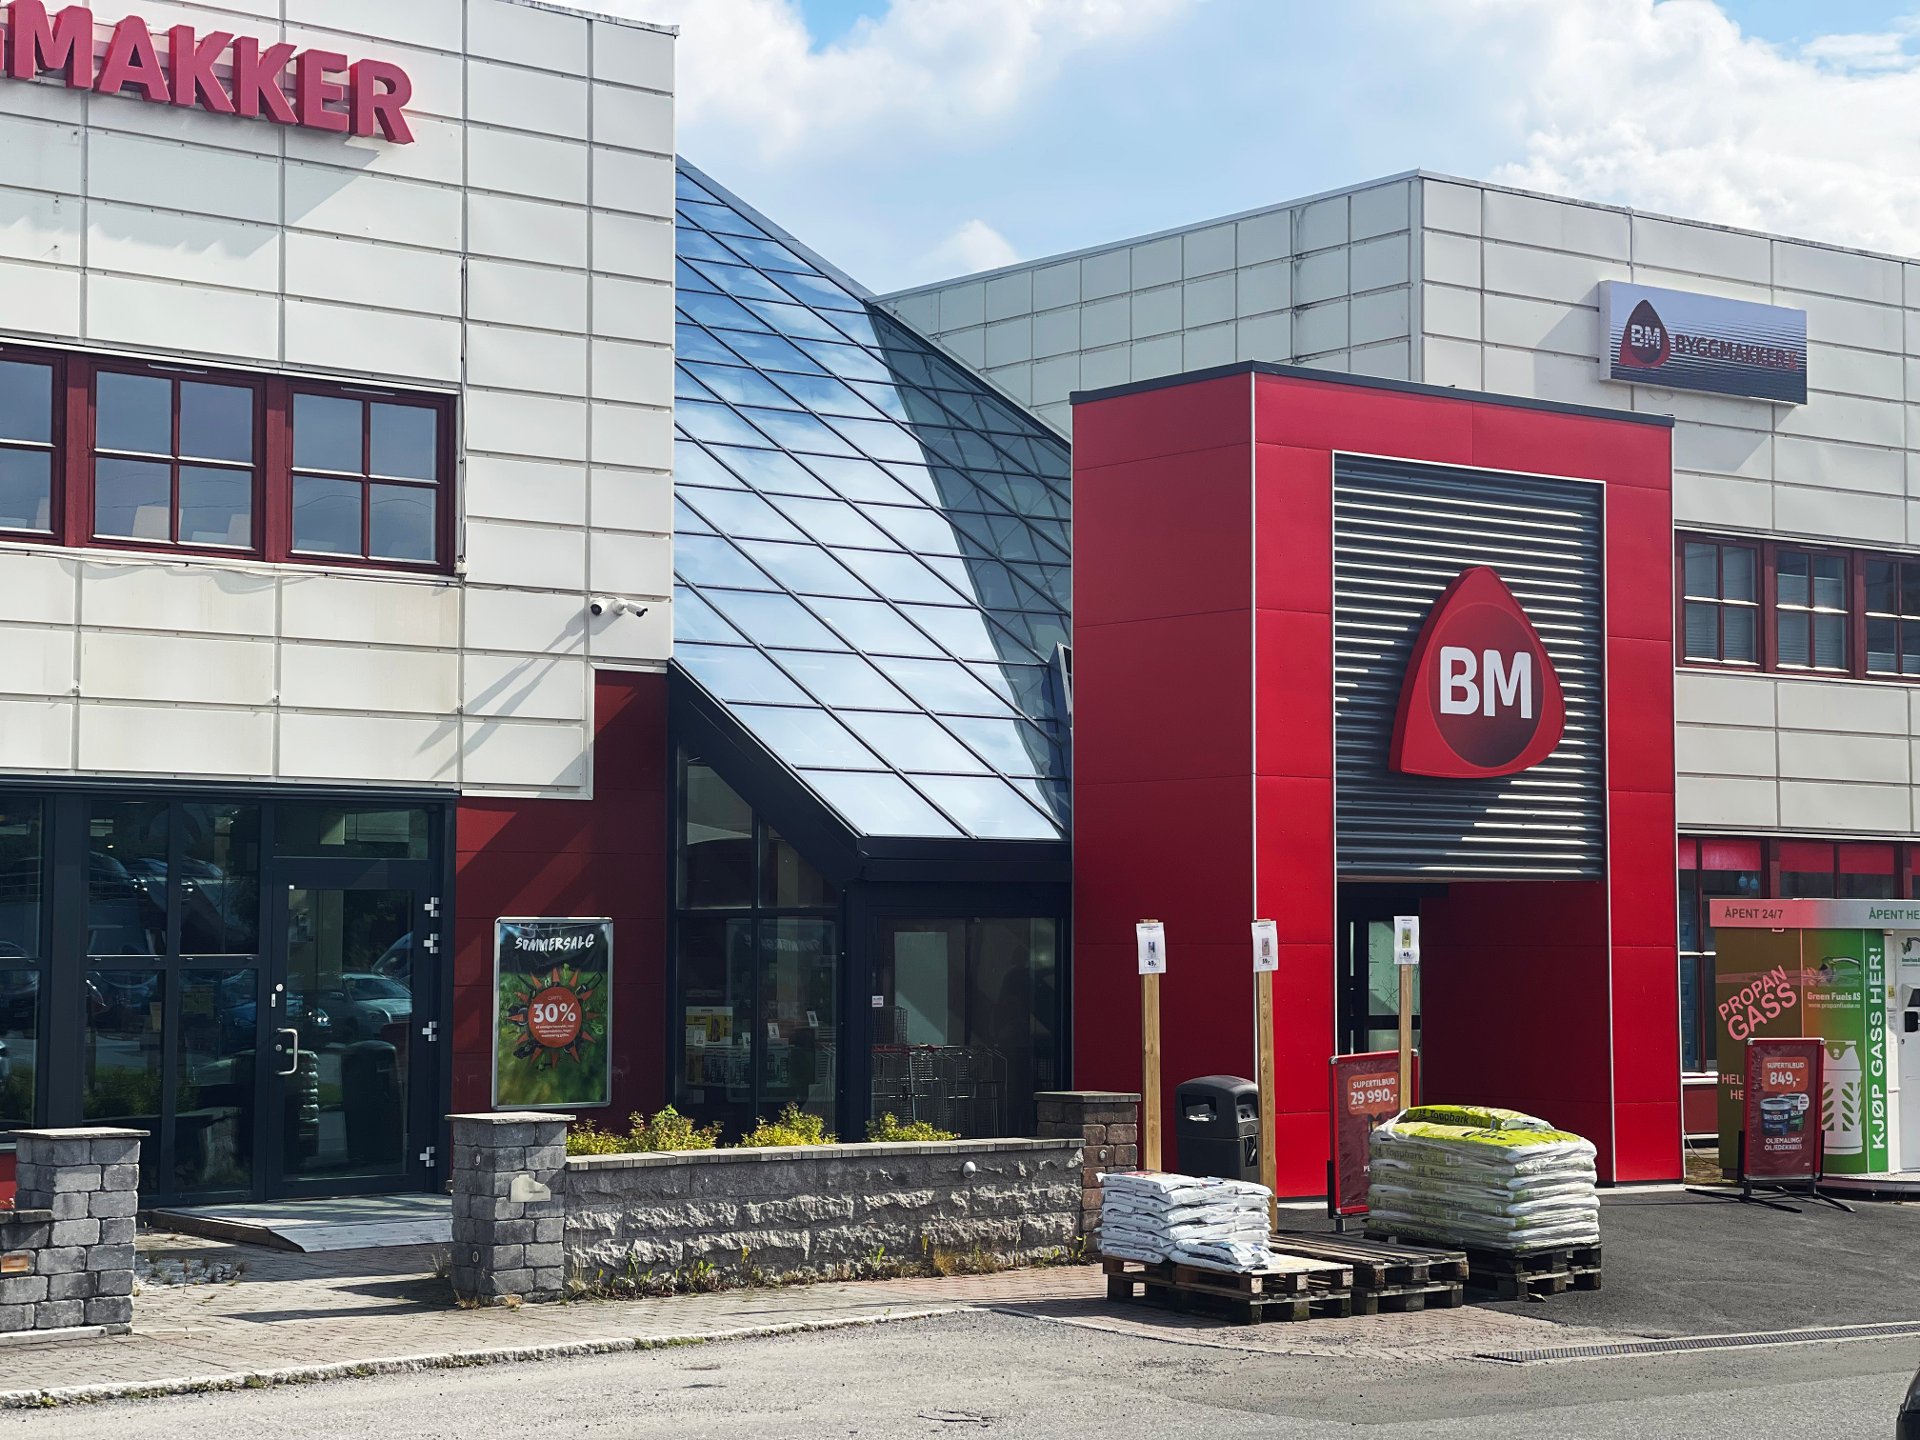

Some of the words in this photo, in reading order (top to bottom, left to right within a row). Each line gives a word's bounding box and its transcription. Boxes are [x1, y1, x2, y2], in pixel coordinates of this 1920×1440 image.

[0, 0, 415, 145] MAKKER
[1631, 324, 1661, 350] BM
[1440, 646, 1532, 719] BM
[1724, 906, 1760, 919] ÅPENT
[1762, 909, 1784, 919] 24/7
[1869, 906, 1905, 920] ÅPENT
[514, 933, 595, 952] SOMMERSALG
[1869, 947, 1882, 1004] HER!
[1718, 964, 1787, 1021] PROPAN
[1807, 991, 1830, 1001] Green
[1831, 991, 1852, 1001] Fuels
[1852, 991, 1861, 1001] AS
[533, 1002, 576, 1023] 30%
[1727, 982, 1797, 1041] GASS
[1869, 1011, 1883, 1077] GASS
[1352, 1077, 1396, 1089] SUPERTILBUD
[1721, 1073, 1744, 1084] HEL
[1770, 1071, 1801, 1088] 849,-
[1350, 1090, 1365, 1105] 29
[1366, 1088, 1398, 1104] 990,-
[1430, 1110, 1469, 1125] Toppbark
[1871, 1084, 1885, 1150] KJØP
